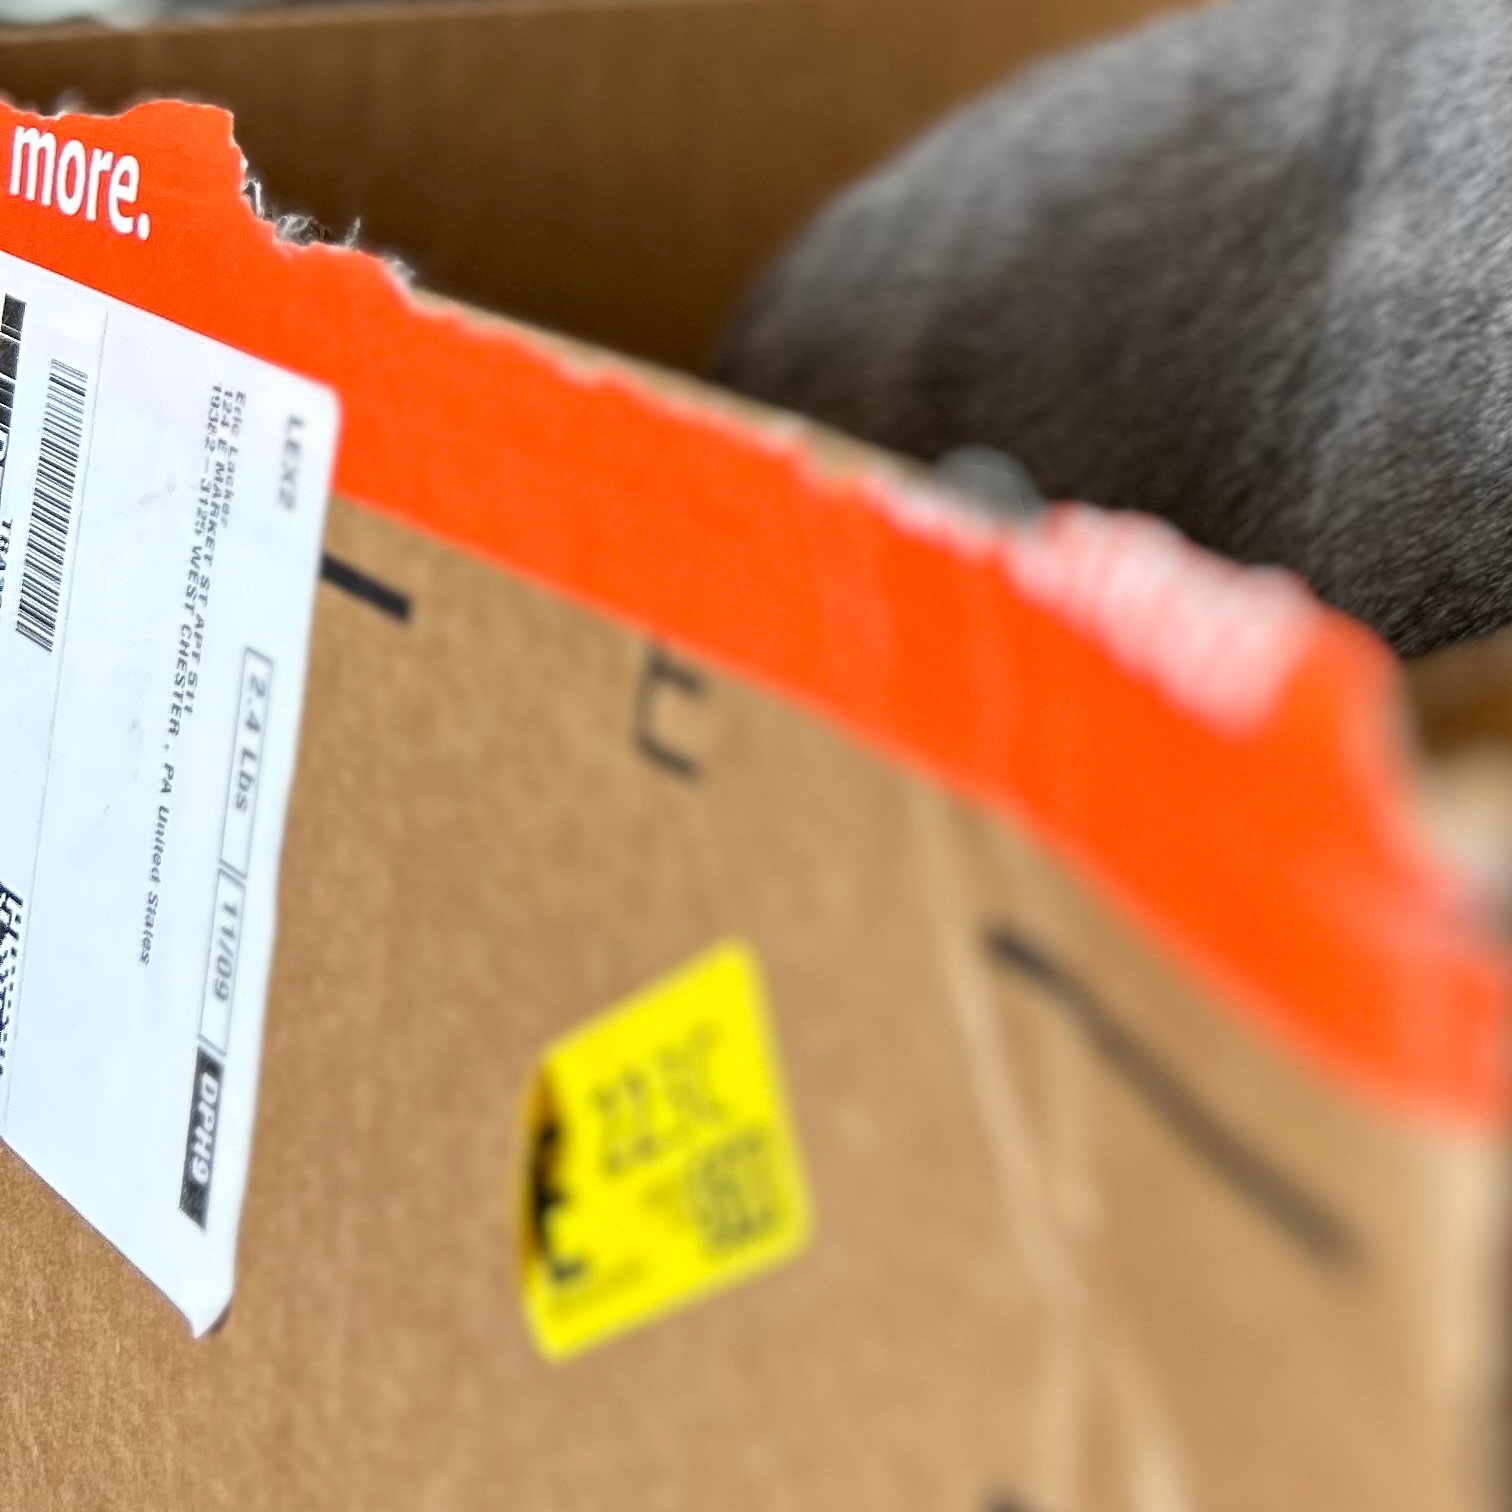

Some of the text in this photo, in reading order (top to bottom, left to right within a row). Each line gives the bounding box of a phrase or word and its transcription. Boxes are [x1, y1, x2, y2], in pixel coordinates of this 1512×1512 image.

[10, 124, 150, 240] more.
[279, 415, 304, 512] LEX2
[203, 461, 225, 567] MARKET
[184, 545, 202, 616] WEST
[199, 574, 210, 608] ST
[168, 623, 192, 736] CHESTER
[192, 613, 205, 665] APT
[161, 762, 174, 793] PA
[235, 674, 266, 812] 2.4 Lbs
[150, 805, 169, 884] United
[140, 890, 159, 965] States
[213, 901, 238, 1002] 11/09
[191, 1071, 218, 1185] DPH9
